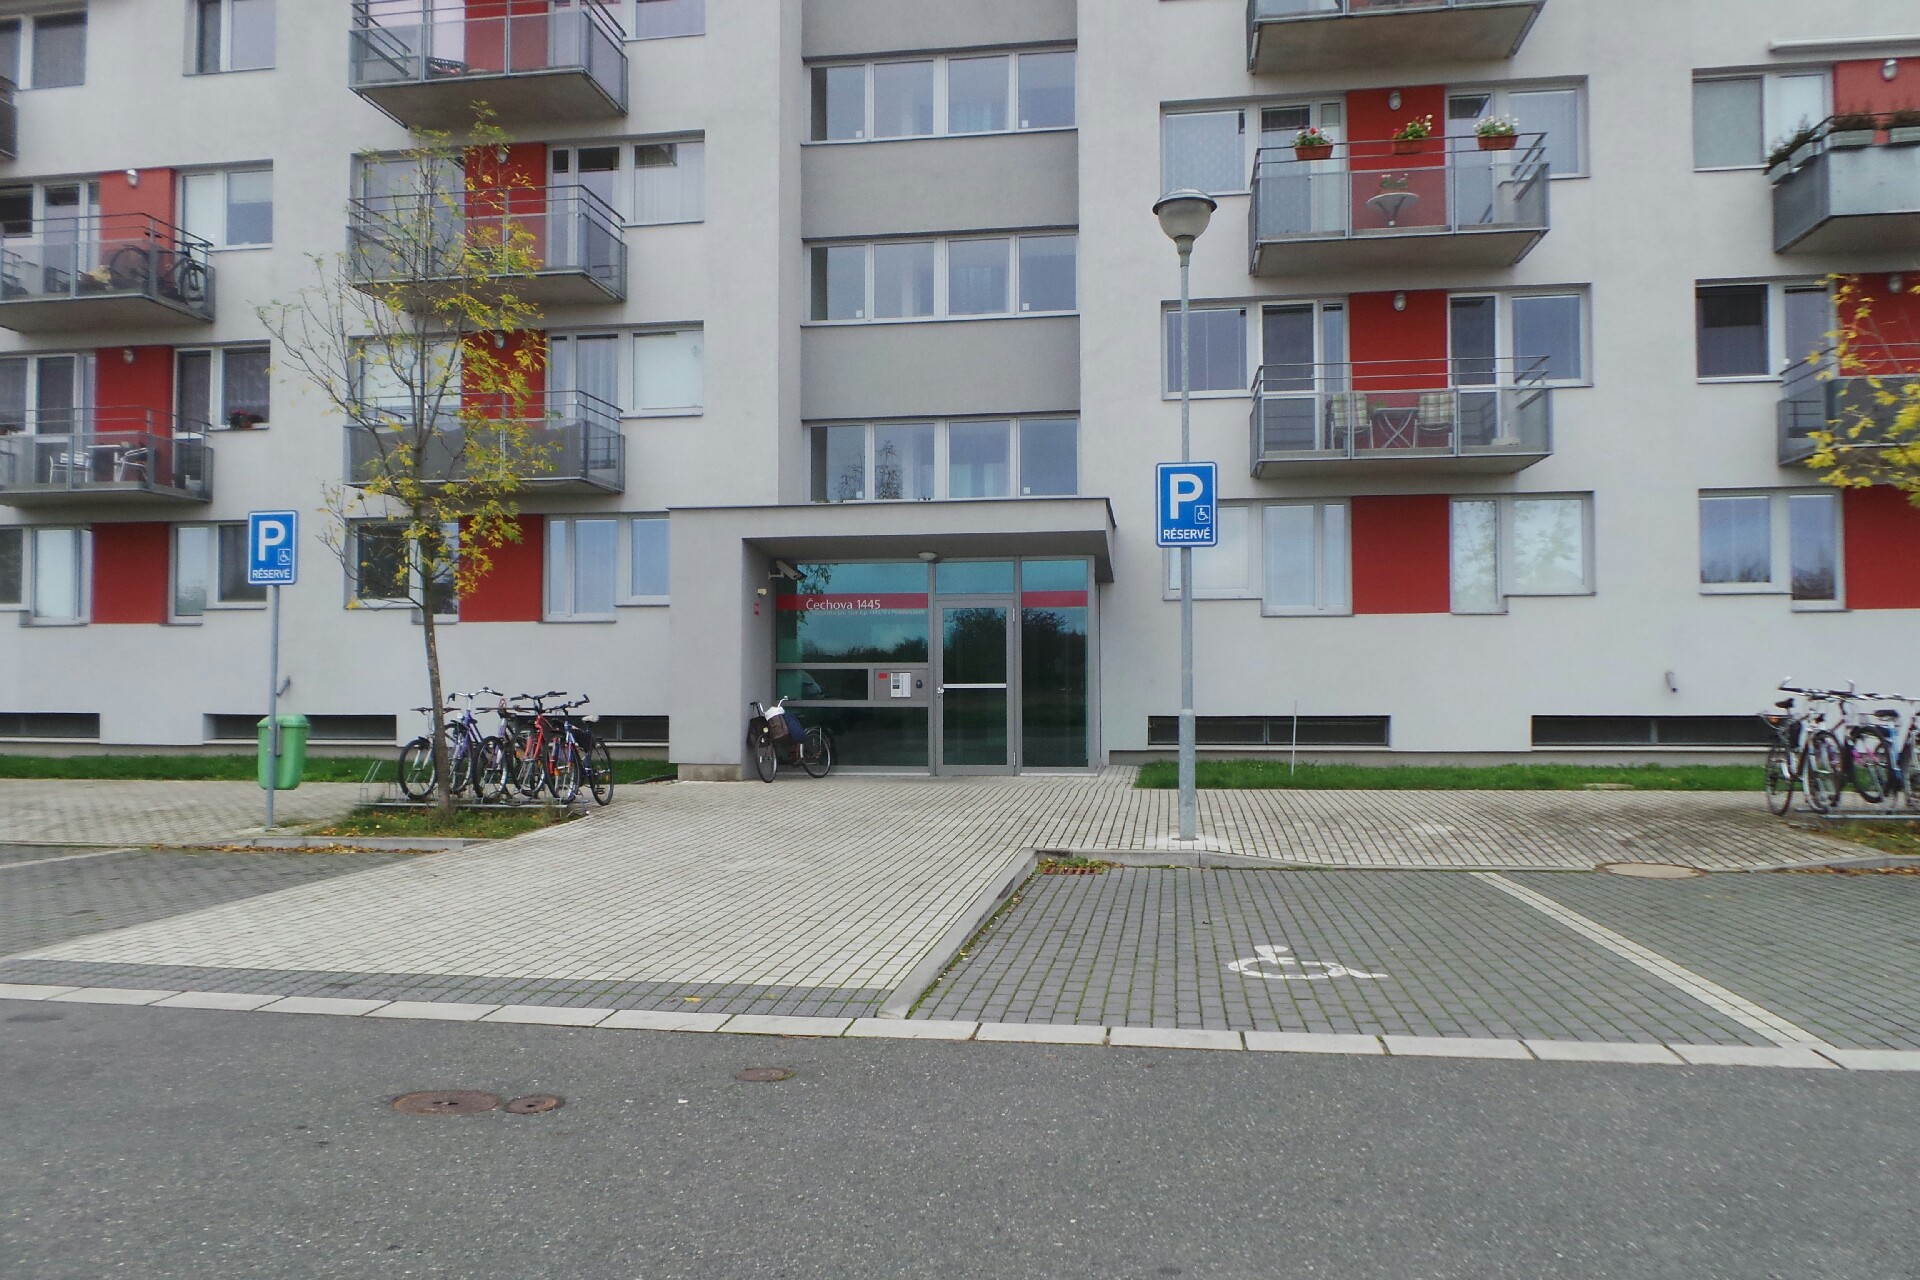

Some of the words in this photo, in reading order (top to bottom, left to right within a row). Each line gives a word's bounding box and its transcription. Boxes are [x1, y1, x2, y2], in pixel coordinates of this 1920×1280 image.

[1169, 473, 1204, 520] P
[258, 520, 286, 562] P
[1163, 527, 1211, 540] RÉSERVÉ
[805, 597, 853, 610] Čechova
[856, 599, 881, 610] 1445
